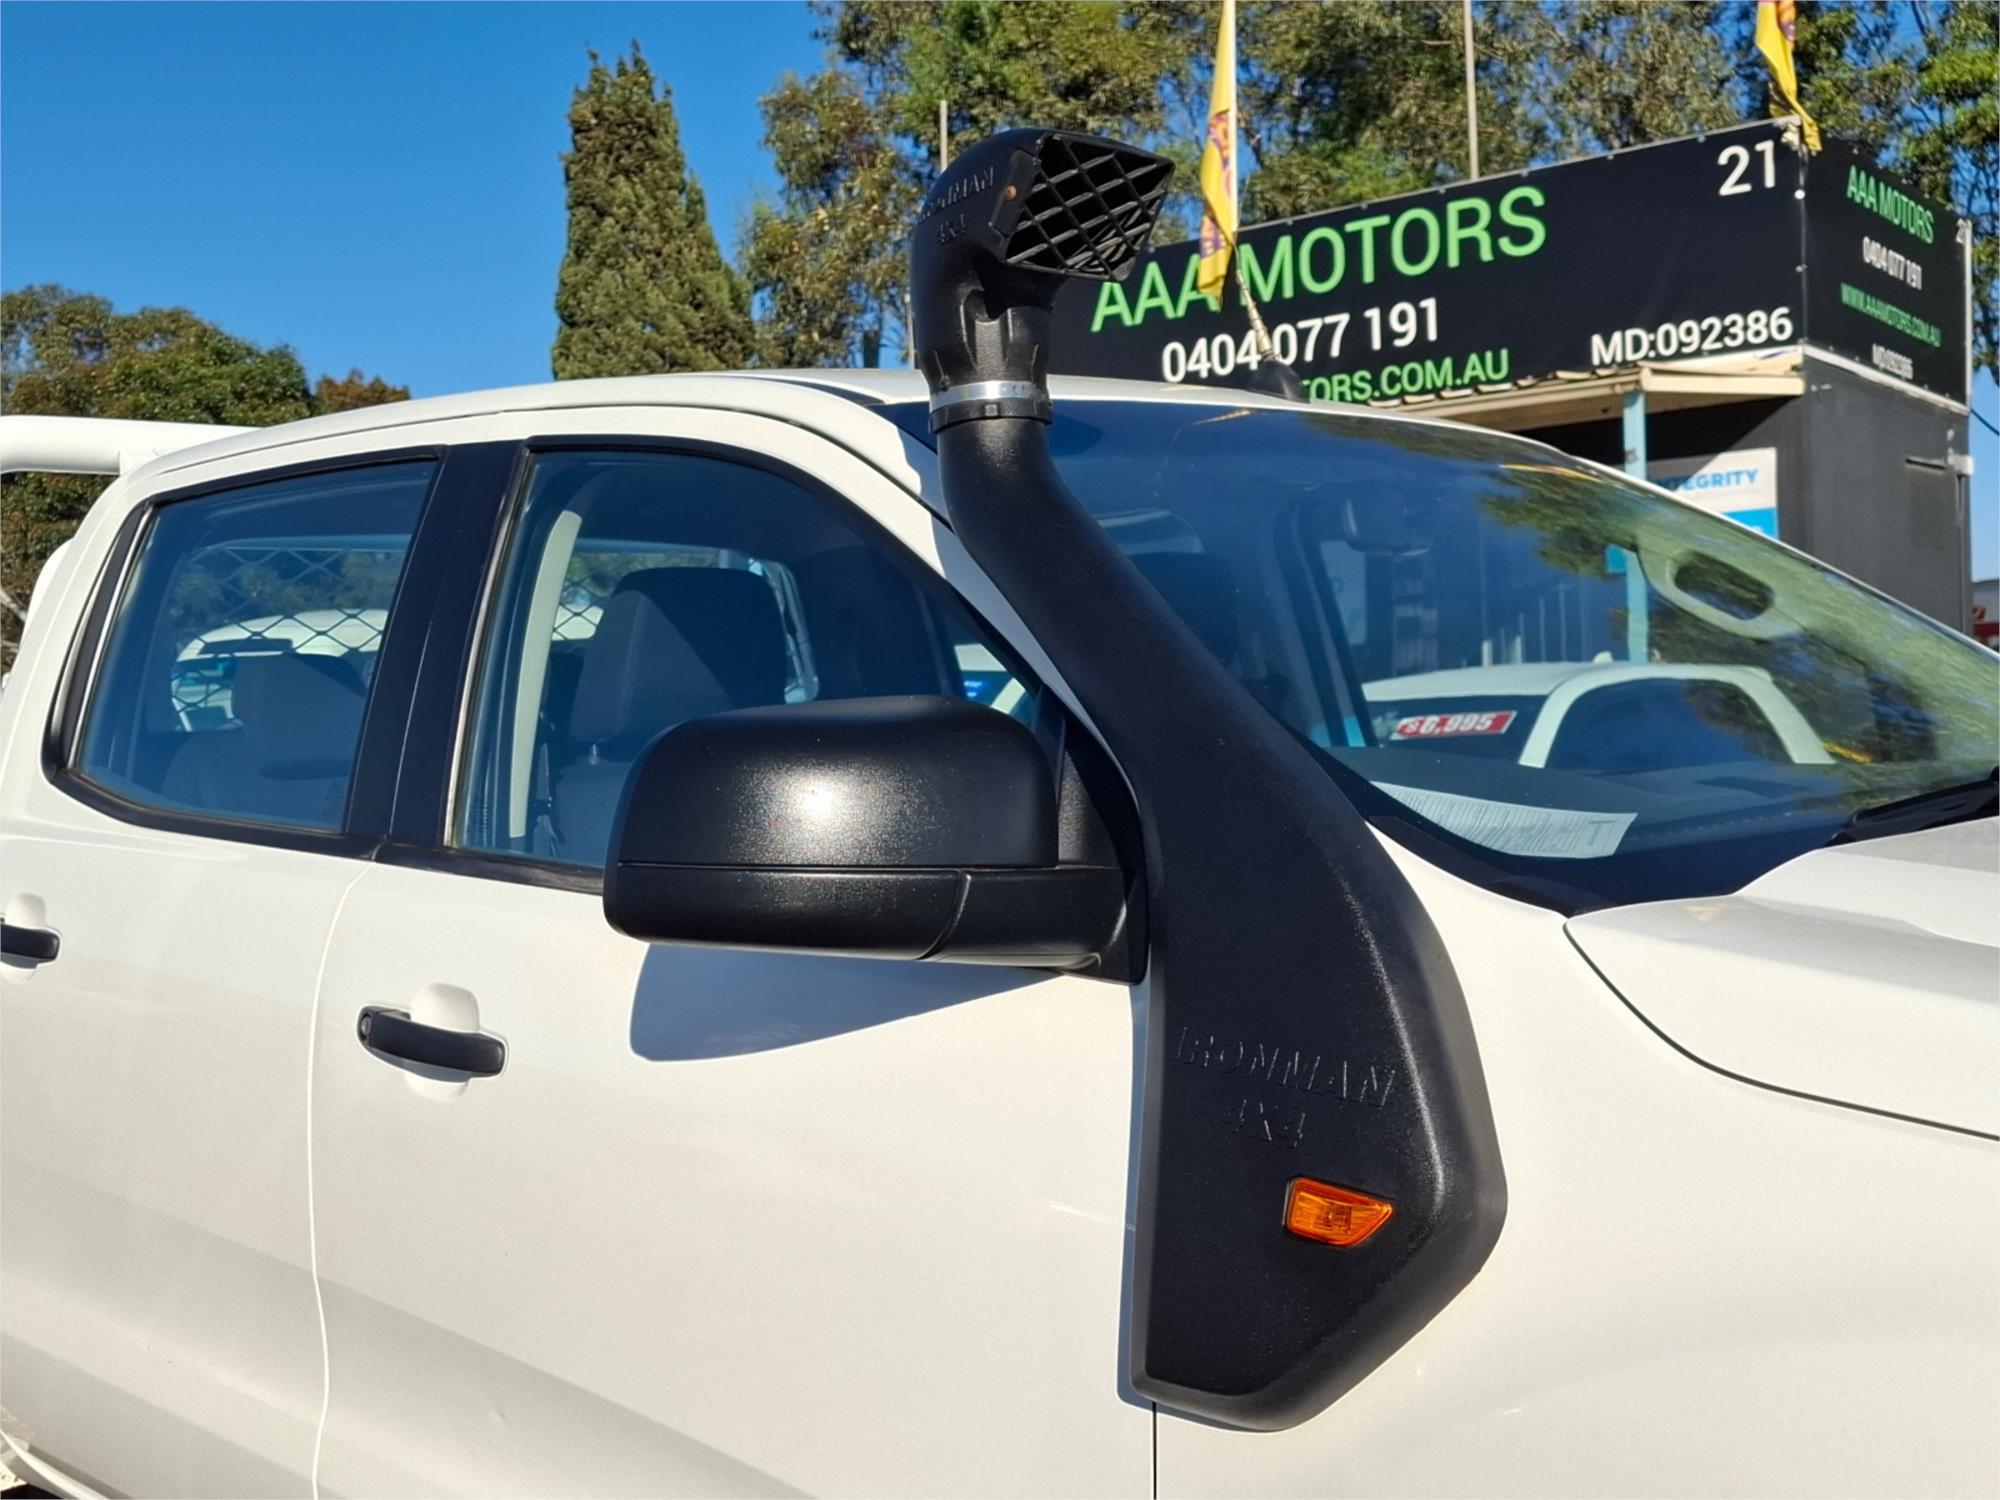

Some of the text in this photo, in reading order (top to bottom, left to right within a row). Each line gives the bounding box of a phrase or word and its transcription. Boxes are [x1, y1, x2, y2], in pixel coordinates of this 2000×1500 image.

[1717, 139, 1776, 197] 21
[1846, 164, 1935, 245] AAA MOTORS
[1090, 185, 1547, 333] AAA MOTORS
[1161, 297, 1438, 383] 0404 077 191
[1590, 306, 1794, 367] MD:092386
